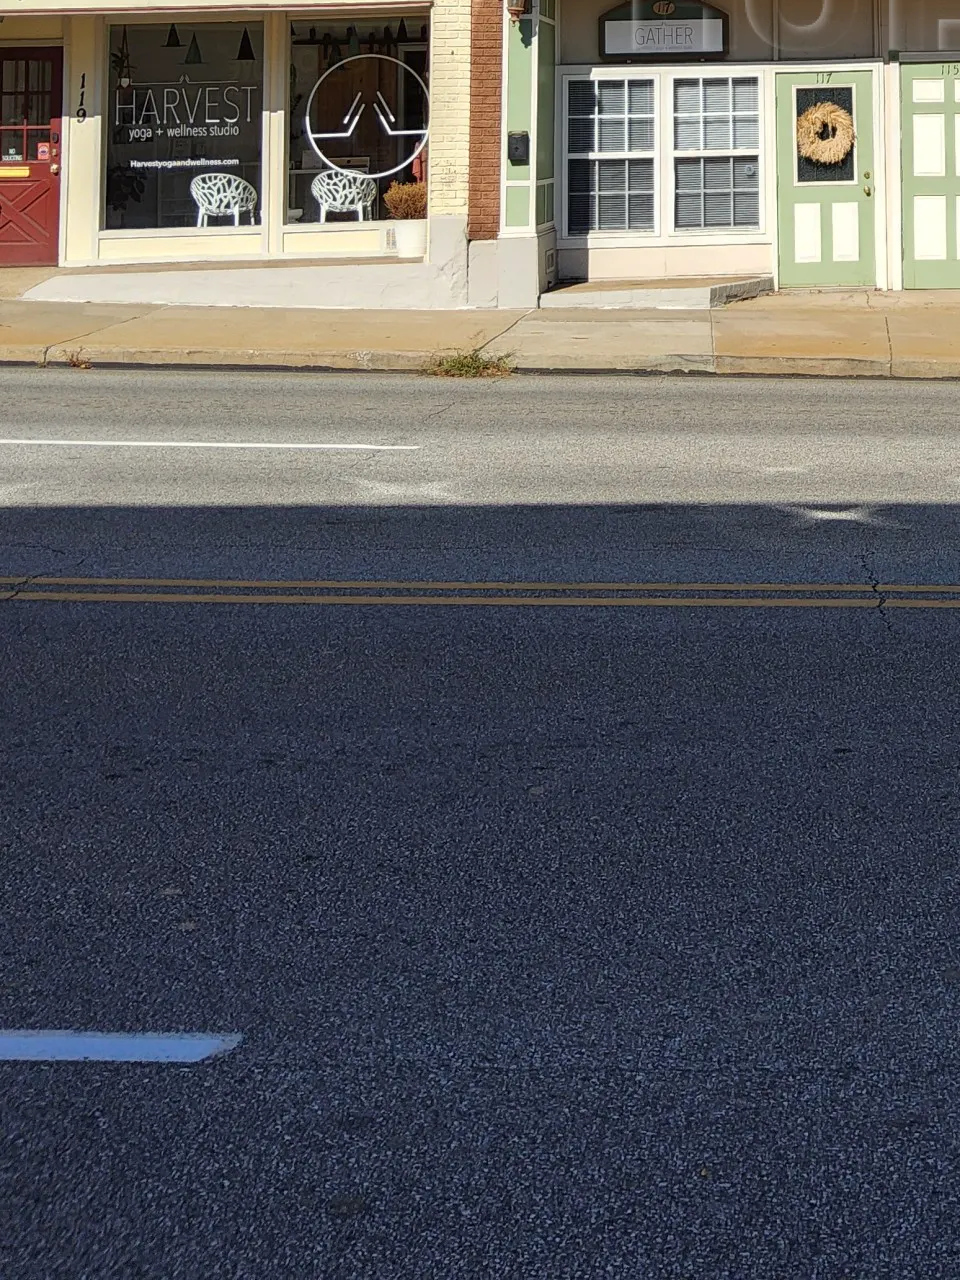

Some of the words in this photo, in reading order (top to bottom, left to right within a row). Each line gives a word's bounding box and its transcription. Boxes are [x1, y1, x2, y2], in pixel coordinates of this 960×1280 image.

[634, 26, 694, 46] GATHER
[815, 72, 832, 84] 117
[940, 64, 960, 76] 115
[76, 73, 87, 124] 119
[115, 86, 257, 126] HARVEST
[129, 128, 153, 141] yoga
[167, 125, 207, 137] wellness
[209, 124, 239, 136] studio
[130, 157, 240, 169] Harvestyogaandwellness.com
